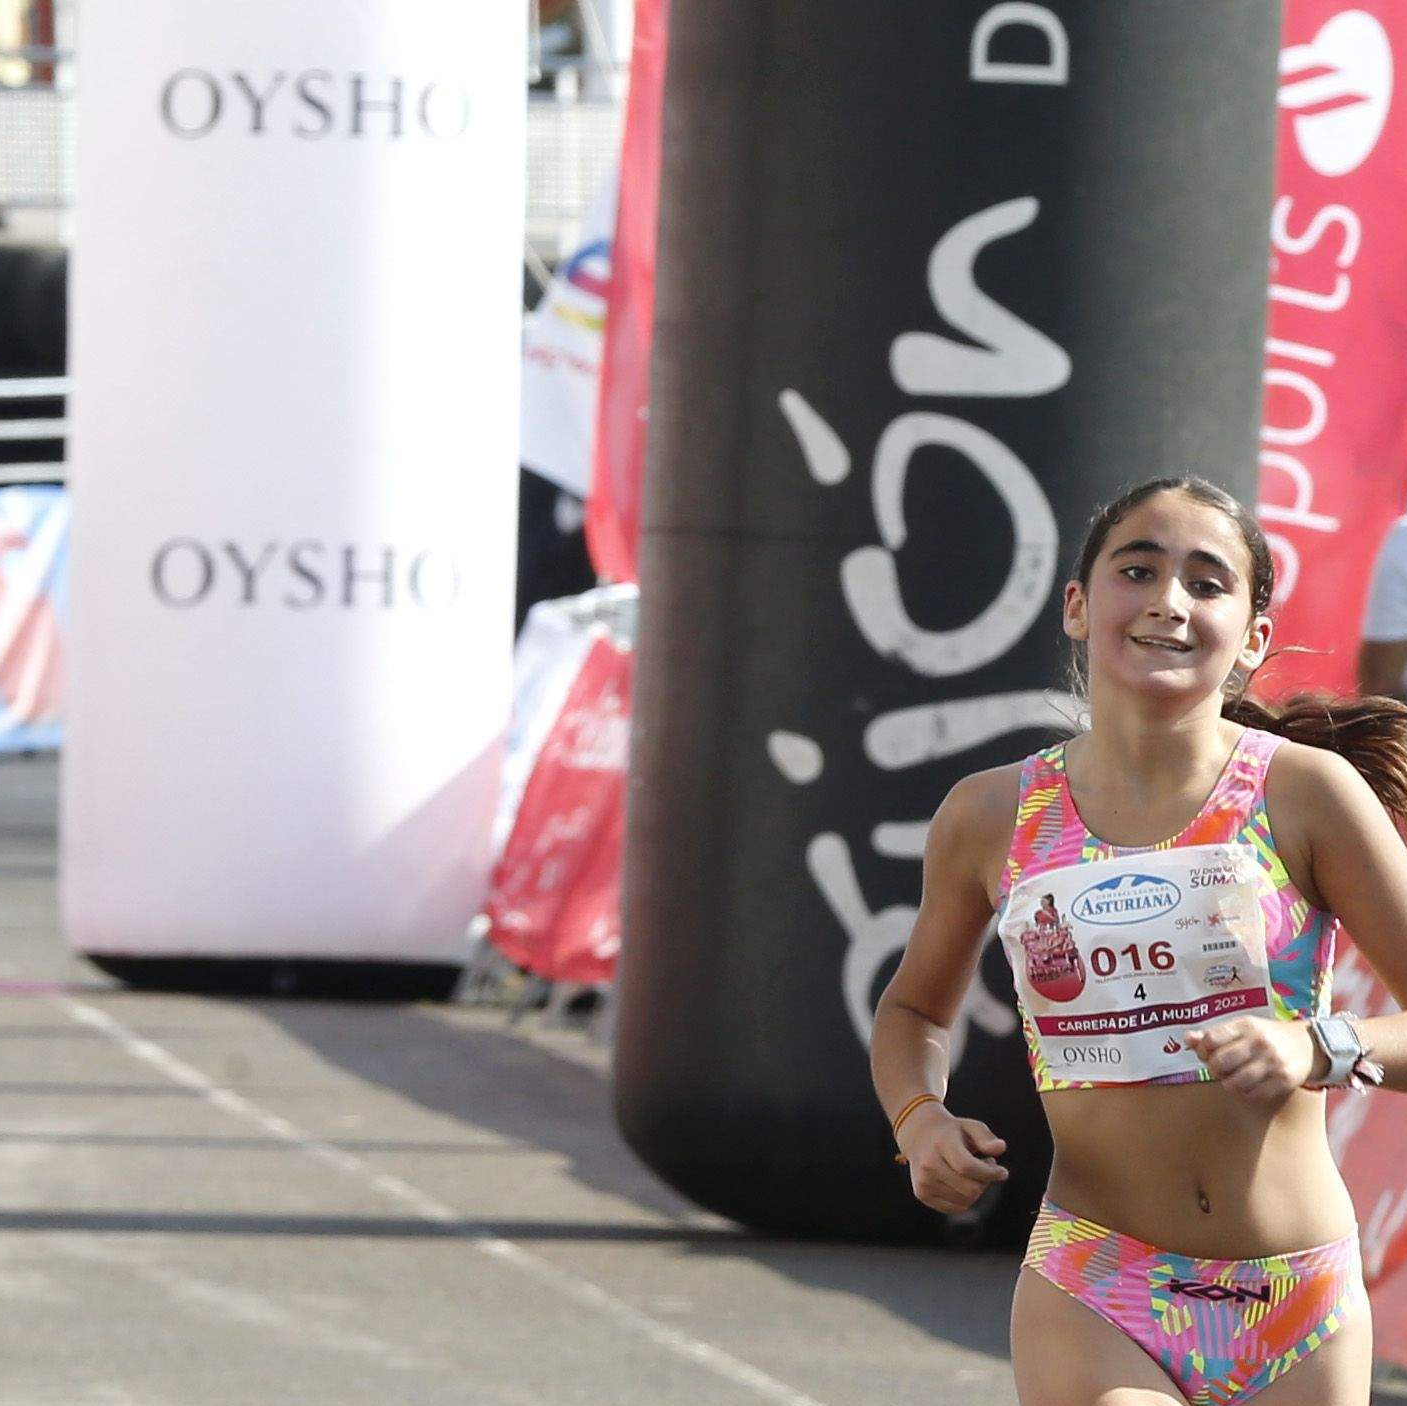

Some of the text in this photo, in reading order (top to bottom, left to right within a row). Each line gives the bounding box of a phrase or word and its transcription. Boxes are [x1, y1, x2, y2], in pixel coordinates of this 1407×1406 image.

[158, 66, 470, 140] OYSHO
[149, 537, 460, 609] OYSHO
[1189, 874, 1238, 889] SUMA
[1080, 893, 1174, 917] ASTURIANA
[1091, 941, 1176, 977] 016
[1134, 983, 1147, 1000] 4
[1058, 994, 1246, 1032] CARRERA DE LA MUJER 2023
[1063, 1047, 1122, 1064] OYSHO
